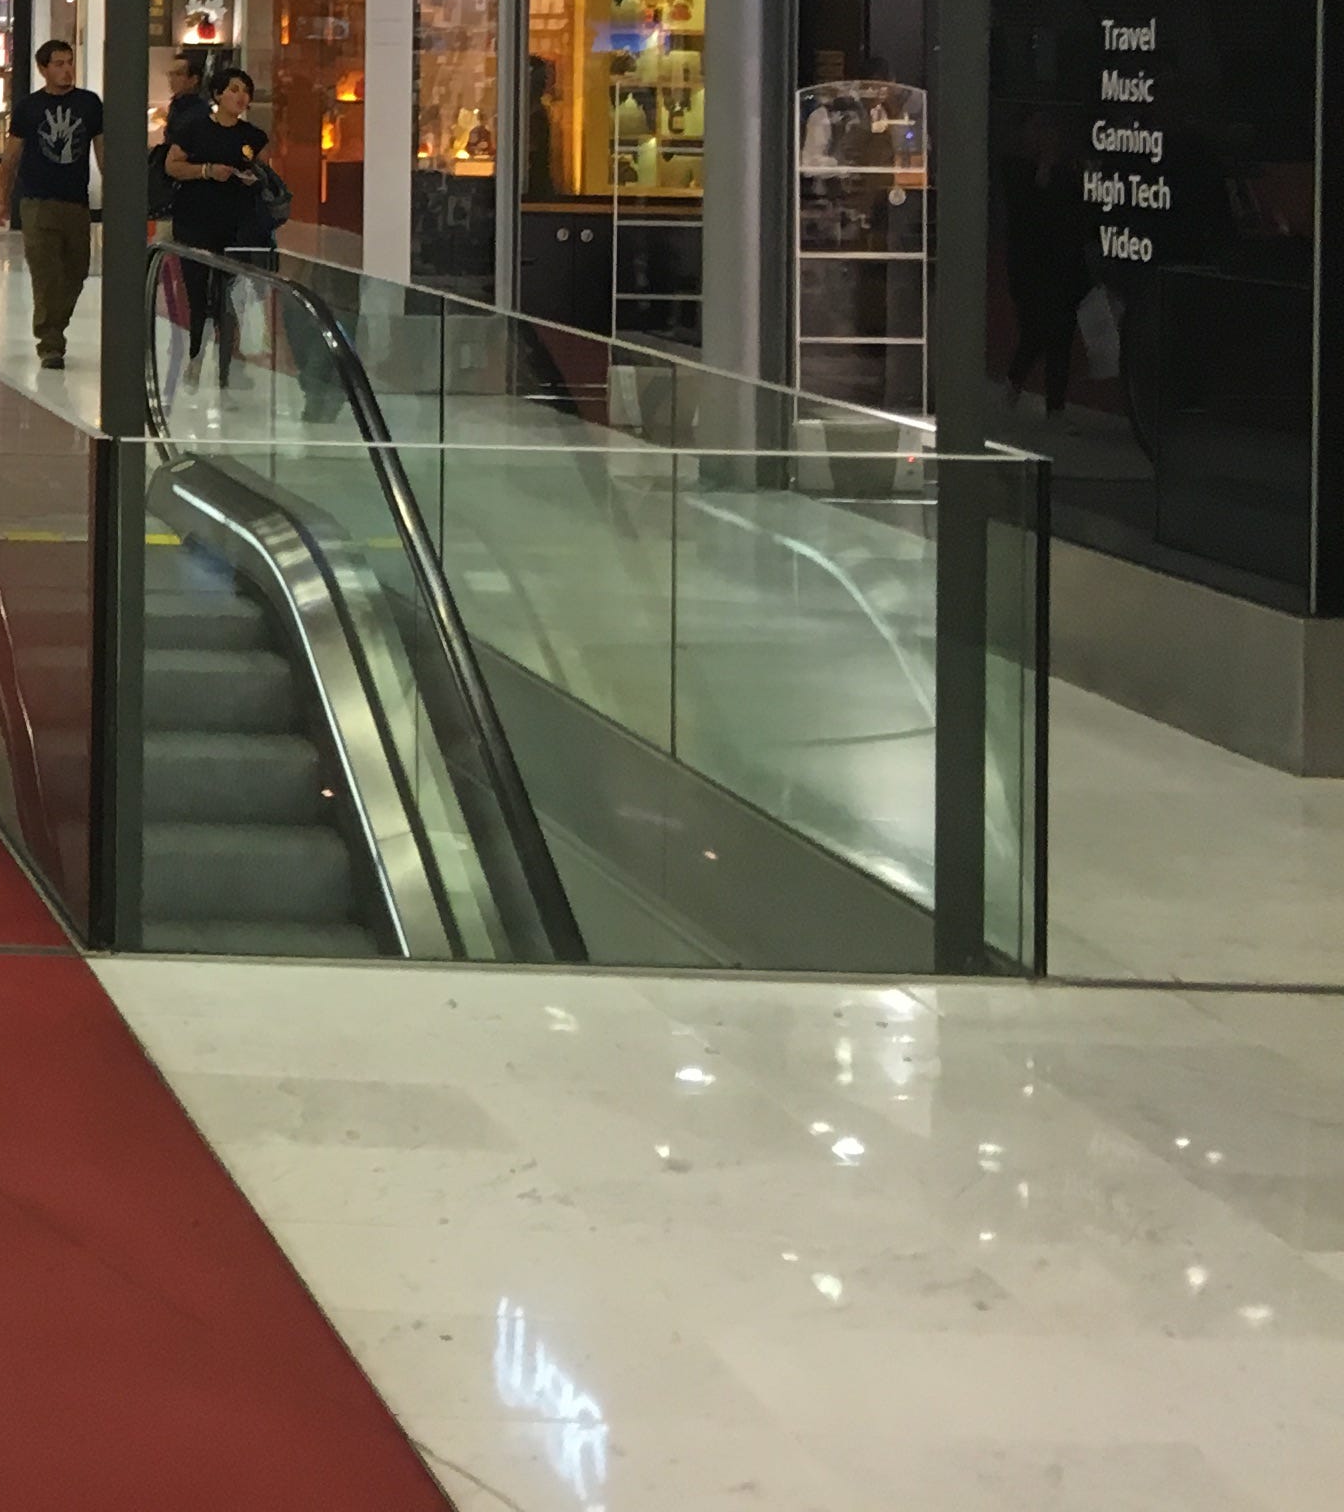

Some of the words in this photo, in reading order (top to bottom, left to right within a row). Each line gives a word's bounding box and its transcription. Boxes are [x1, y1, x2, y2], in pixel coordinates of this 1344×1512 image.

[1101, 18, 1156, 52] Travel
[1101, 70, 1154, 103] Music
[1092, 120, 1163, 163] Gaming
[1083, 170, 1125, 212] High
[1128, 174, 1170, 210] Tech
[1099, 225, 1153, 262] Video
